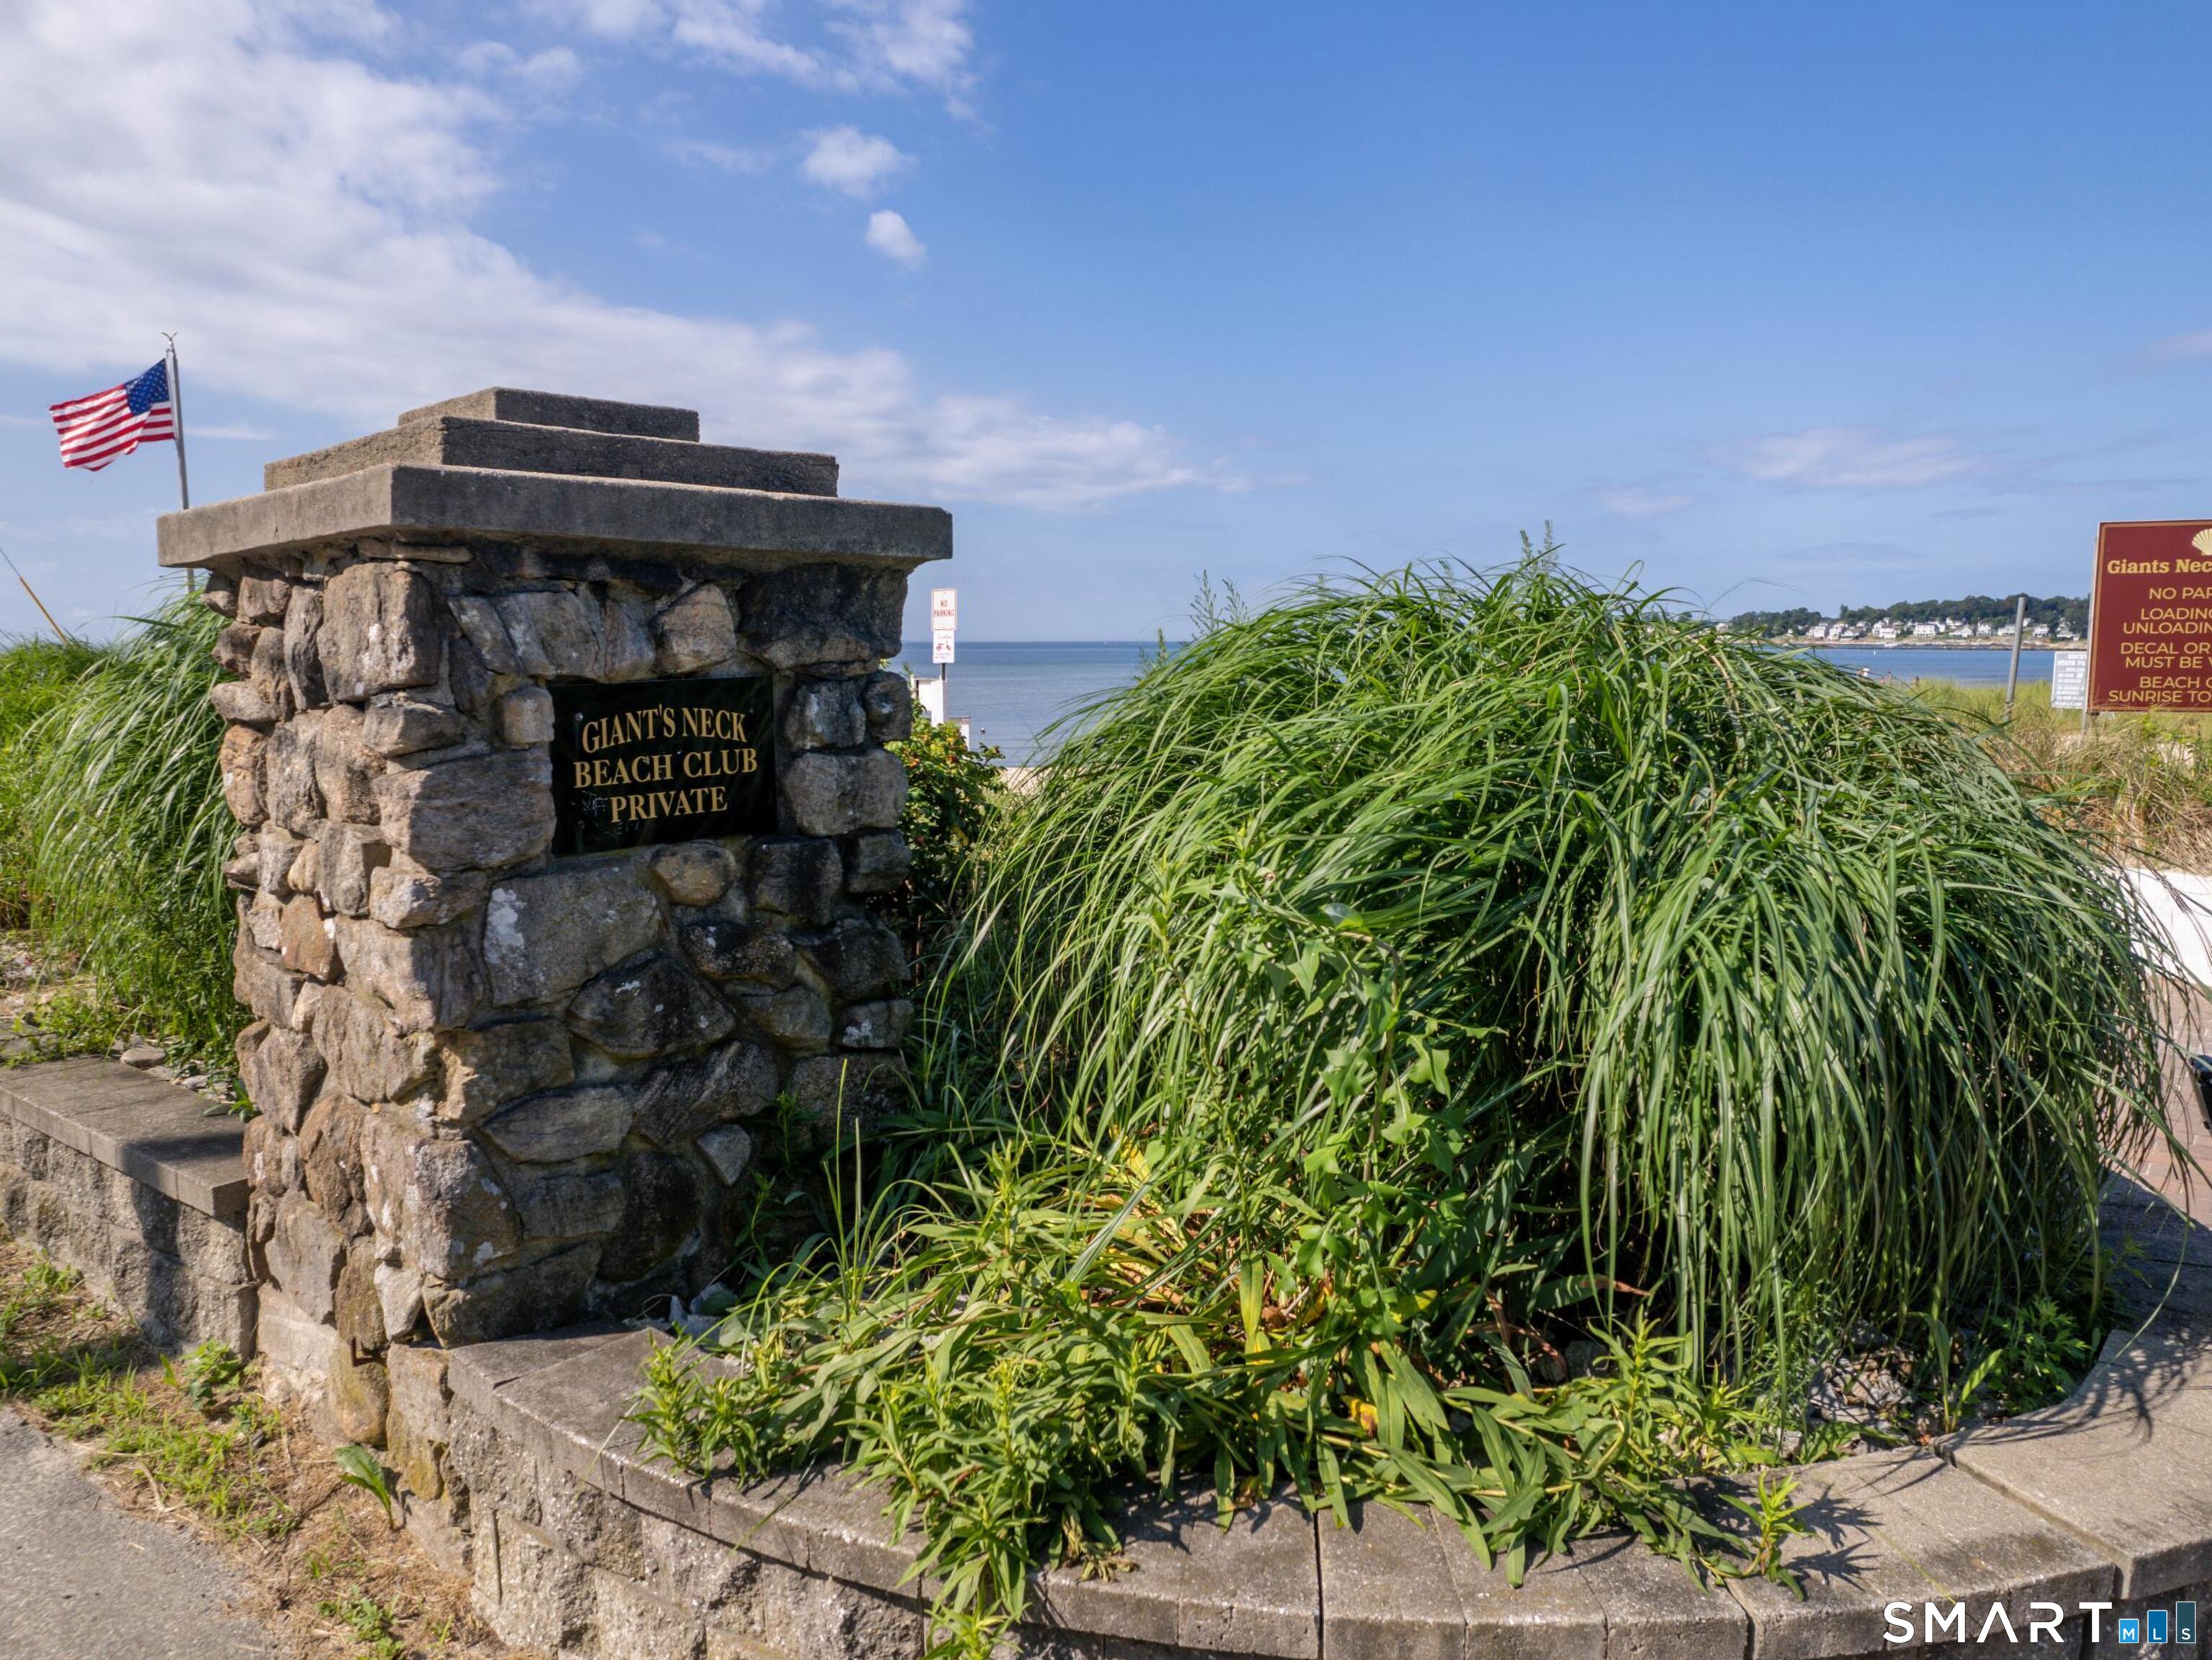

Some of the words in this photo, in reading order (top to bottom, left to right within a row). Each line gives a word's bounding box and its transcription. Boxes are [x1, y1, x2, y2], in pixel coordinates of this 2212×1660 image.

[2107, 560, 2170, 574] Giants
[2149, 587, 2177, 599] NO
[2121, 642, 2179, 655] DECAL
[2184, 642, 2211, 654] OR
[2125, 656, 2175, 669] MUST
[2180, 656, 2203, 669] BE
[2139, 677, 2200, 689] BEACH
[2108, 690, 2183, 703] SUNRISE
[2188, 690, 2212, 702] TO
[582, 704, 675, 754] GIANT'S
[681, 708, 748, 743] NECK
[573, 754, 674, 789] BEACH
[683, 748, 758, 778] CLUB
[609, 786, 728, 824] PRIVATE
